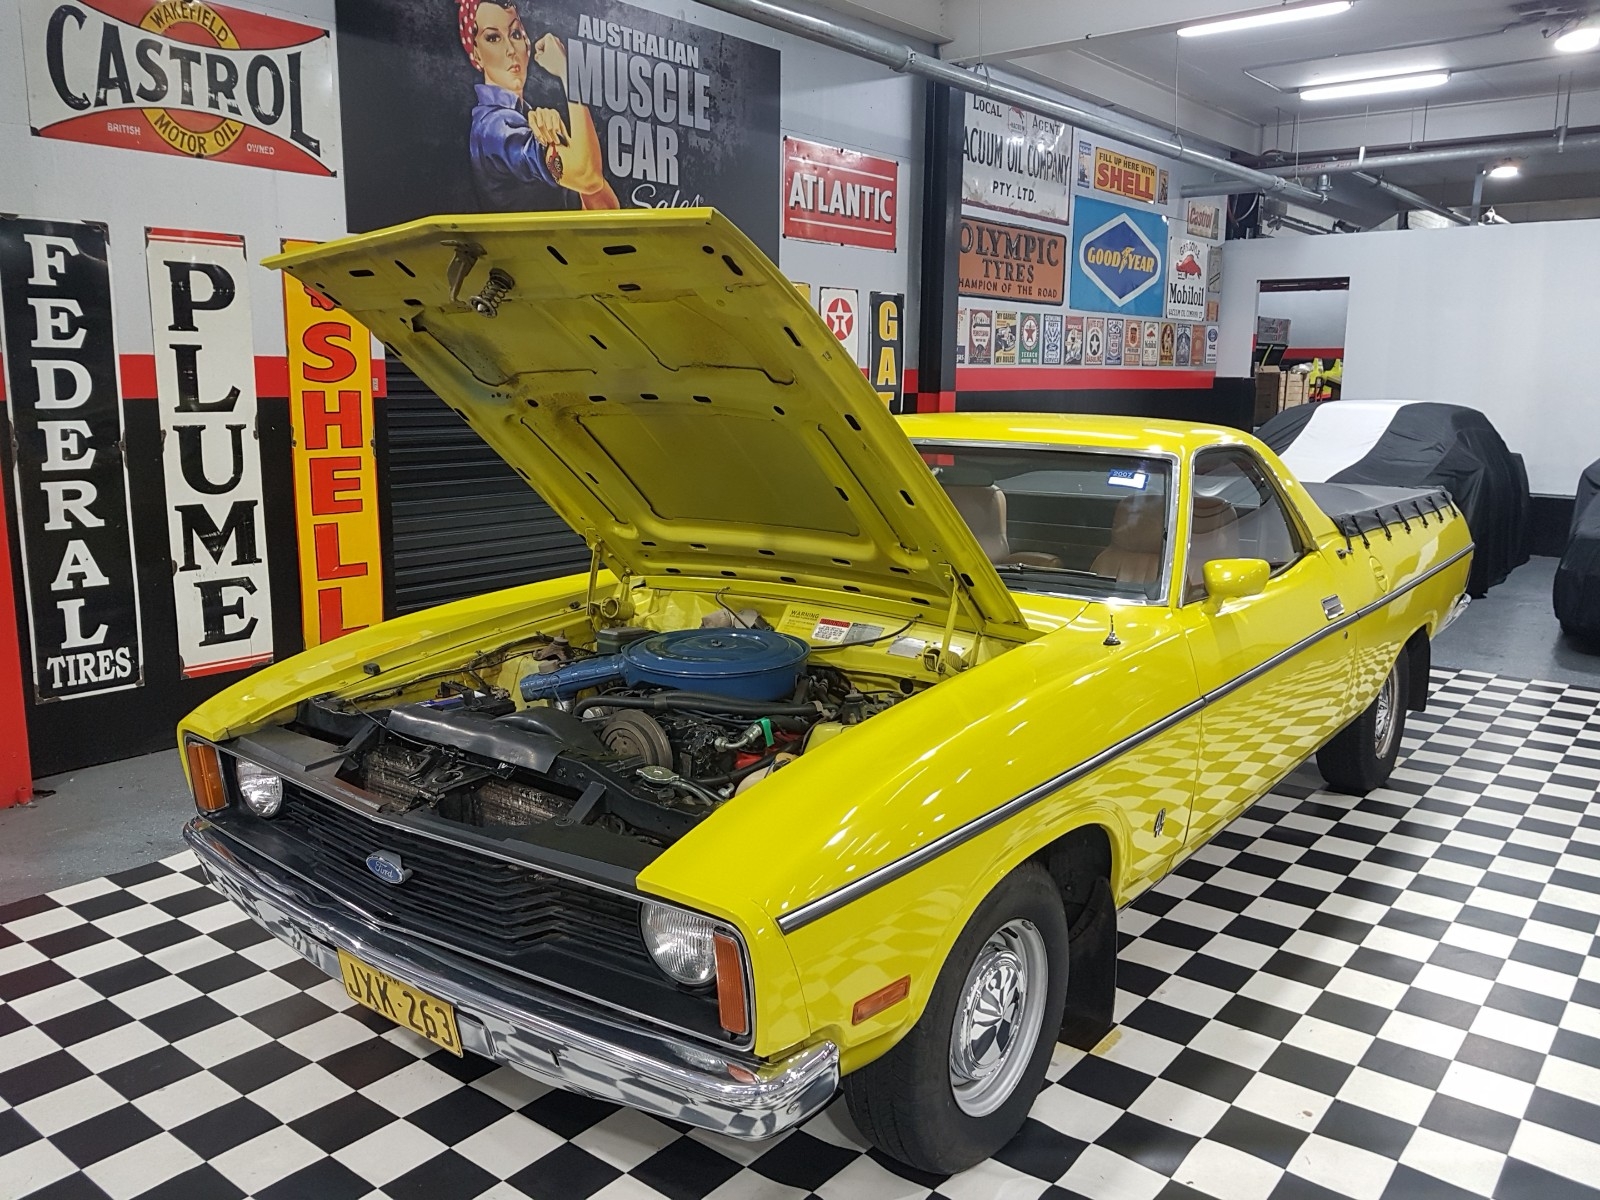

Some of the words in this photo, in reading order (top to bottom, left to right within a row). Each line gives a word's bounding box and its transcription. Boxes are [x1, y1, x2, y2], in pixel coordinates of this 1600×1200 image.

[150, 3, 229, 43] WAKEFIELD
[577, 13, 699, 69] AUSTRALIAN
[46, 4, 321, 157] CASTROL
[567, 38, 711, 132] MUSCLE
[107, 122, 141, 136] BRITISH
[154, 113, 207, 154] MOTOR
[213, 122, 238, 148] OIL
[973, 94, 1002, 118] LOCAL
[1032, 115, 1060, 136] AGENT
[246, 143, 275, 155] OWNED
[607, 115, 679, 186] CAR
[962, 126, 1003, 169] ACUUM
[1007, 140, 1024, 174] OIL
[1027, 144, 1070, 186] COMPANY
[1099, 152, 1113, 164] FILL
[1113, 156, 1122, 167] UP
[1123, 159, 1140, 172] HERE
[1141, 164, 1155, 177] WITH
[788, 171, 893, 223] ATLANTIC
[992, 180, 1014, 199] PTY.
[1017, 186, 1037, 204] LTD.
[1097, 162, 1154, 200] SHELL
[1190, 207, 1213, 229] Castrol
[959, 222, 1059, 267] OLYMPIC
[1087, 246, 1155, 274] GOODYEAR
[959, 278, 998, 293] HAMPION
[1001, 283, 1012, 293] OF
[1017, 284, 1033, 296] THE
[1038, 288, 1058, 299] ROAD
[982, 258, 1034, 284] TYRES
[1168, 283, 1205, 307] Mobiloil
[23, 234, 110, 649] FEDERAL
[163, 260, 262, 647] PLUME
[302, 322, 370, 645] SHELL
[791, 610, 820, 619] WARNING
[46, 646, 132, 689] TIRES
[379, 971, 400, 986] NSW
